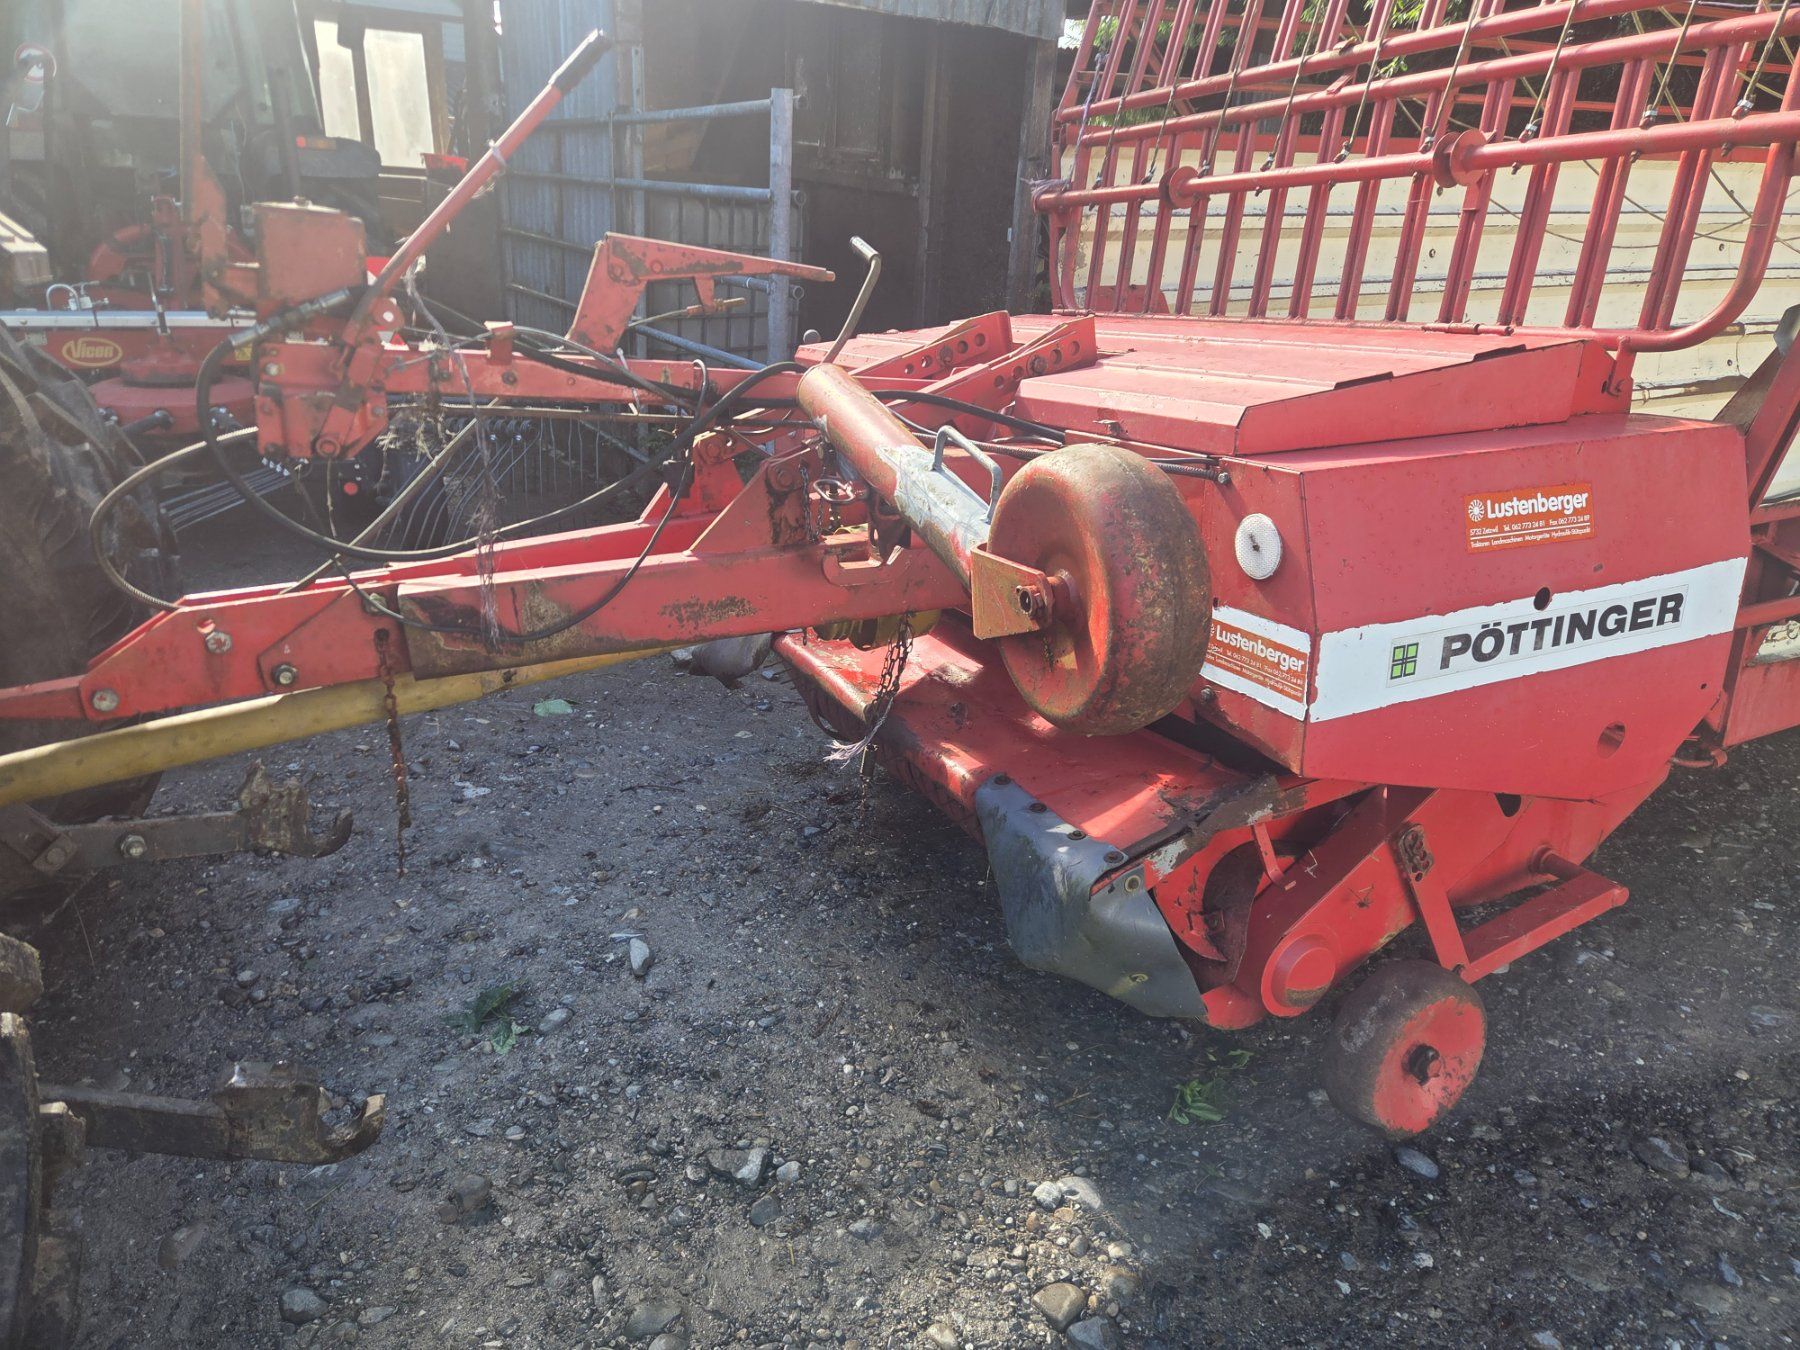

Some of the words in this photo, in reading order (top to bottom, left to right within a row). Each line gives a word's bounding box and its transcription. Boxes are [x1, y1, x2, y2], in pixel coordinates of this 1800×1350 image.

[1487, 493, 1588, 519] Lustenberger
[1512, 523, 1521, 531] 062
[1522, 522, 1531, 530] 773
[1216, 625, 1304, 672] Lustenberger
[1440, 592, 1684, 670] PÖTTINGER
